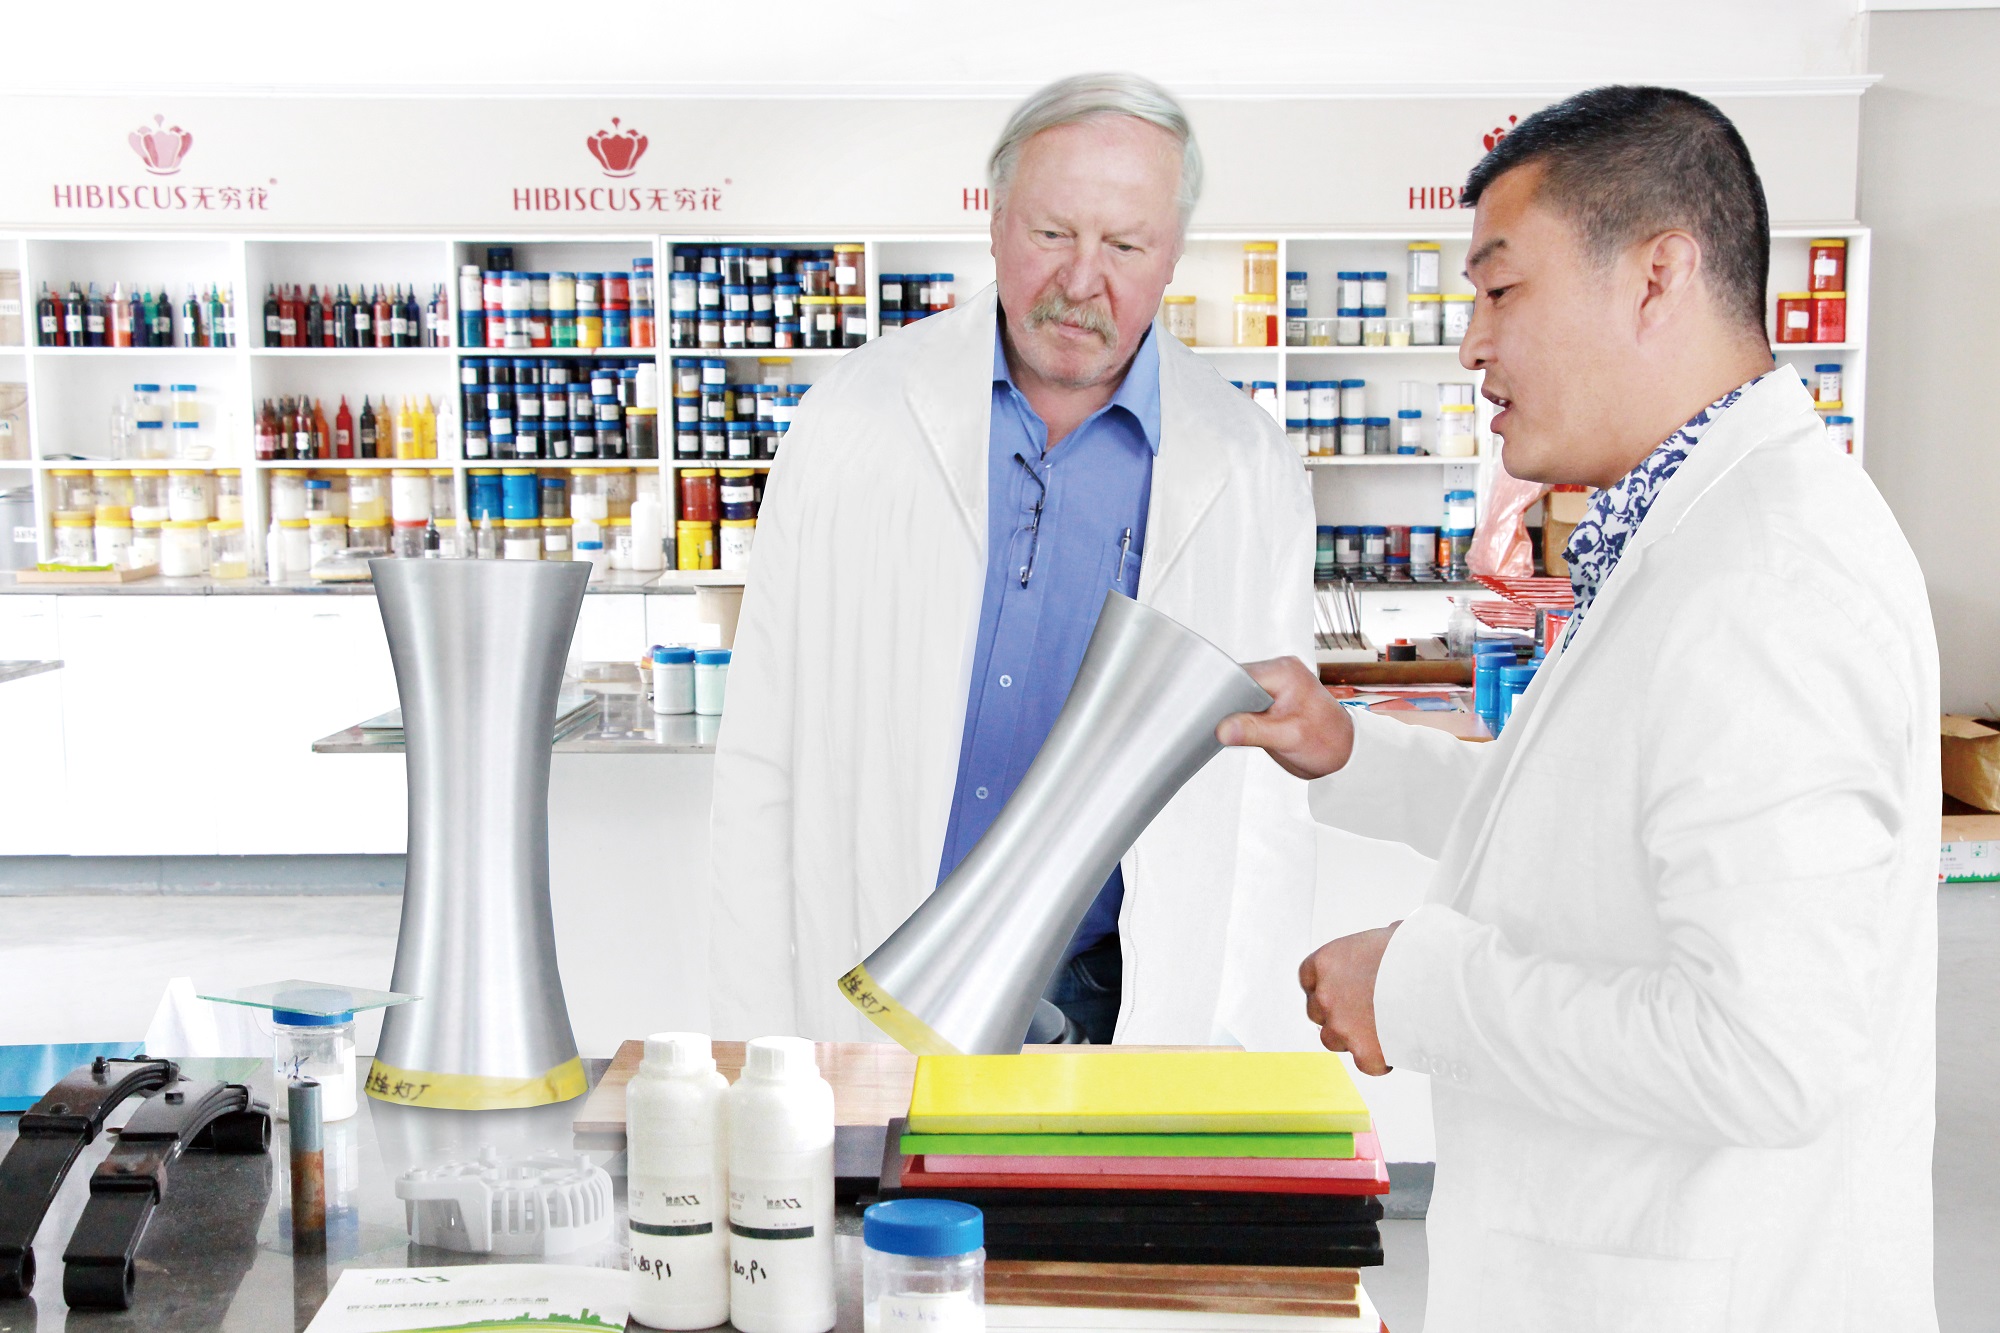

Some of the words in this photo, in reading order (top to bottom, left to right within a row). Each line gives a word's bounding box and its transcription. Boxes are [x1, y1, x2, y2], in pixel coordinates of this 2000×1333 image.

[54, 184, 188, 209] HIBISCUS
[192, 187, 270, 210] 无穷花
[513, 187, 641, 211] HIBISCUS
[646, 187, 723, 211] 无穷花
